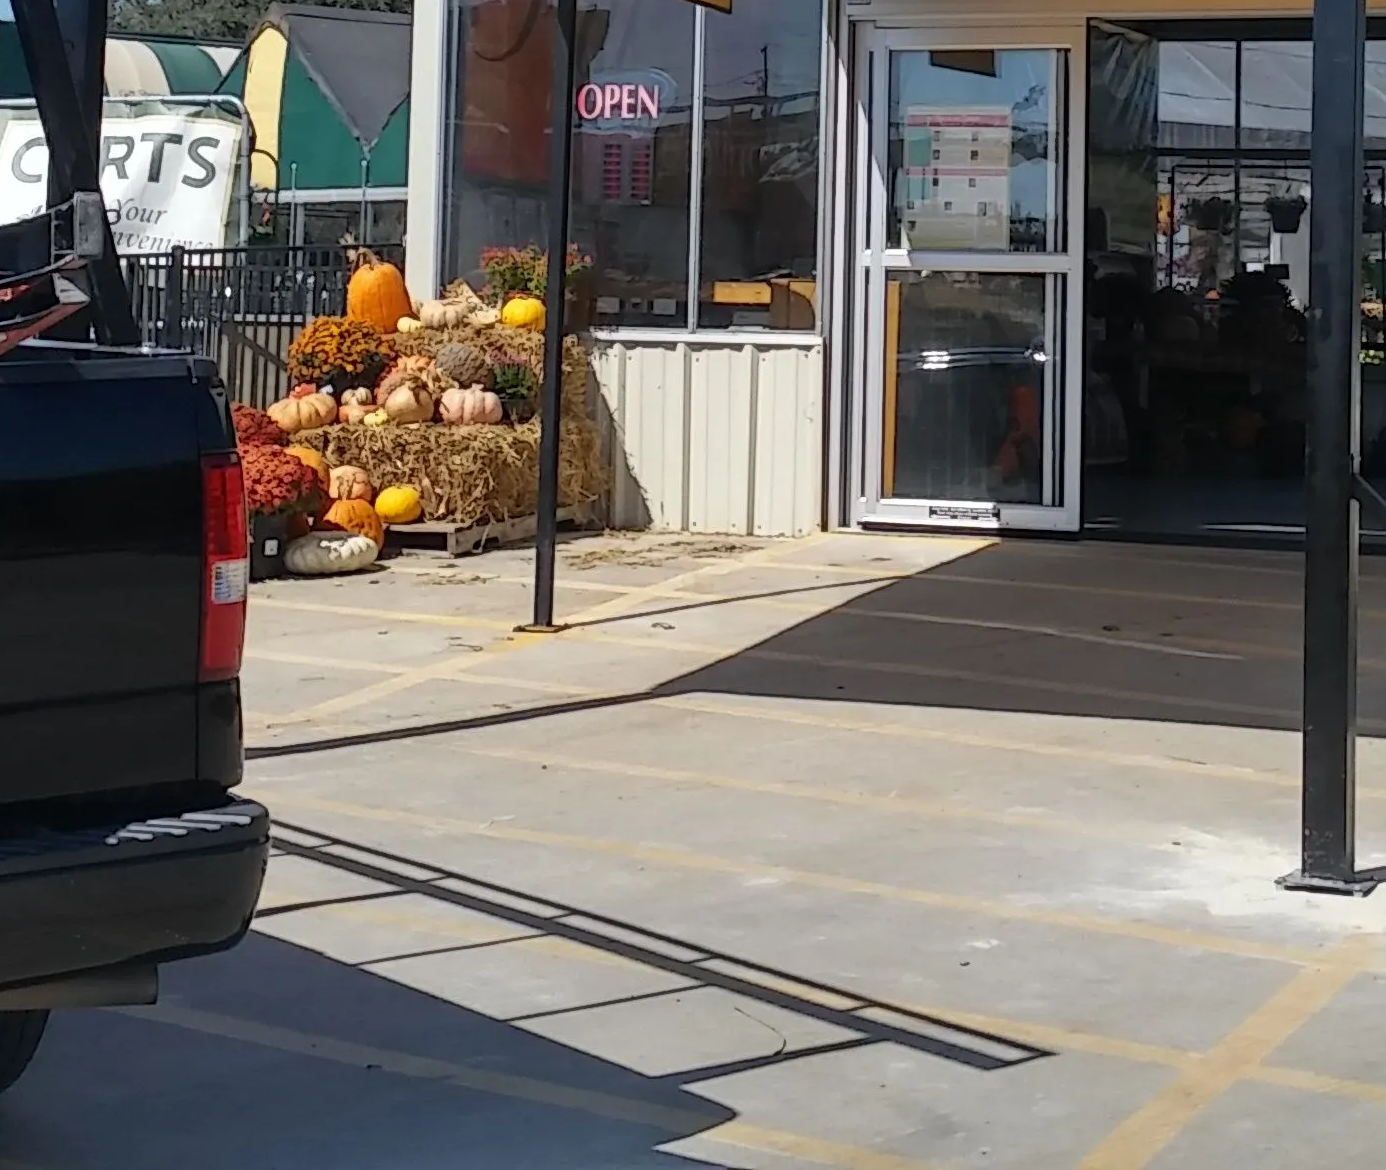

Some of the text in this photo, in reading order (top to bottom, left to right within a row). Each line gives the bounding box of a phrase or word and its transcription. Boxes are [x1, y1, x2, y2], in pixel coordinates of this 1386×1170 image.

[577, 83, 660, 119] OPEN
[11, 132, 221, 189] CRTS
[111, 198, 168, 225] Your
